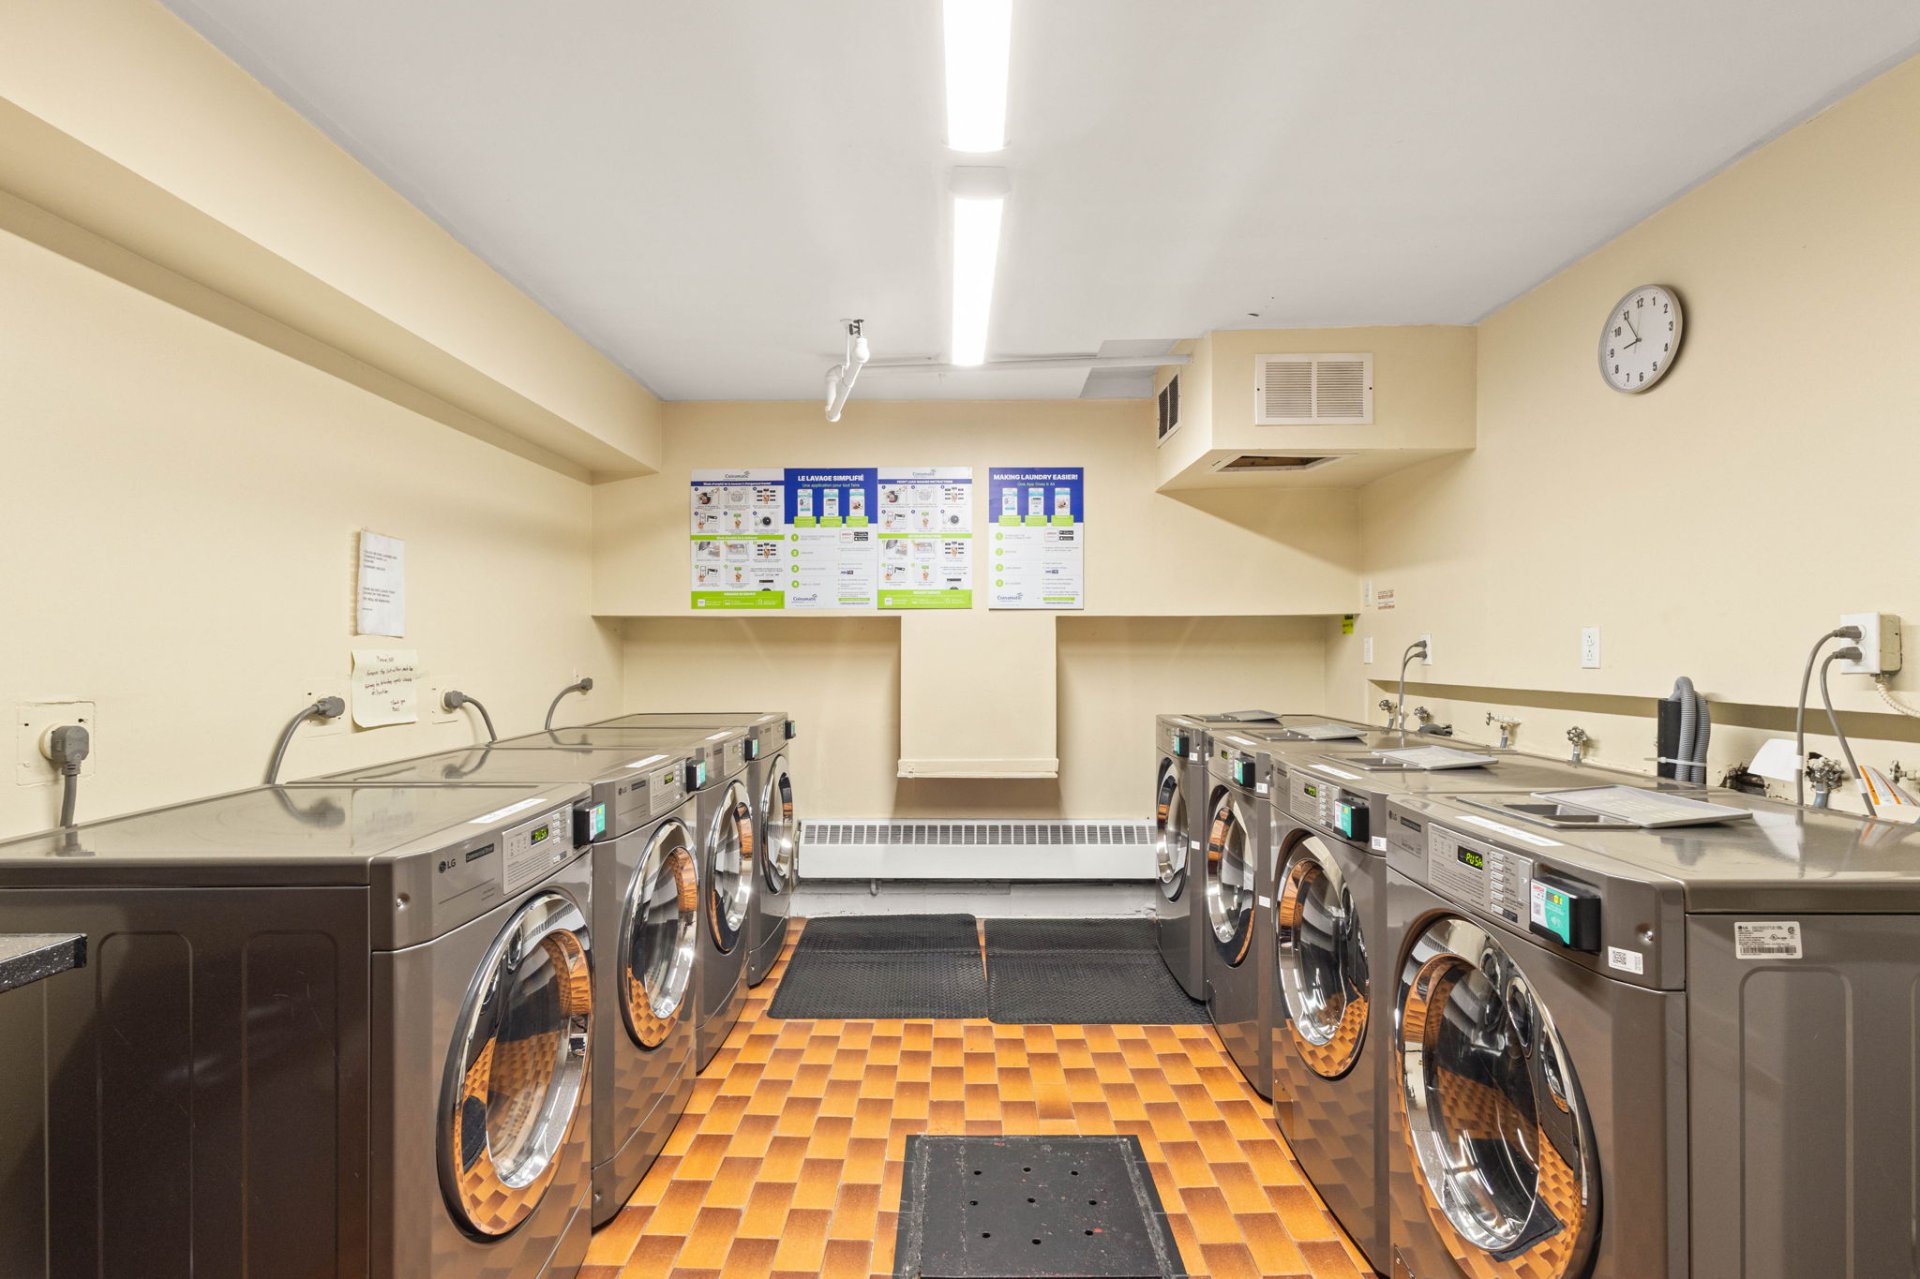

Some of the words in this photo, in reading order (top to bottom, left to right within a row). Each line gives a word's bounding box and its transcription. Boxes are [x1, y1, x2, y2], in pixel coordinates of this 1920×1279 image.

[1636, 297, 1644, 309] 12
[1652, 296, 1656, 307] 1
[1663, 303, 1669, 314] 2
[1623, 310, 1630, 321] 11
[1668, 320, 1674, 332] 3
[1614, 326, 1622, 338] 10
[1663, 342, 1669, 352] 4
[1609, 348, 1615, 358] 9
[1614, 364, 1619, 375] 8
[1652, 361, 1658, 372] 5
[1626, 372, 1630, 383] 7
[1639, 372, 1644, 382] 6
[832, 474, 864, 482] SIMPLIFIÉ
